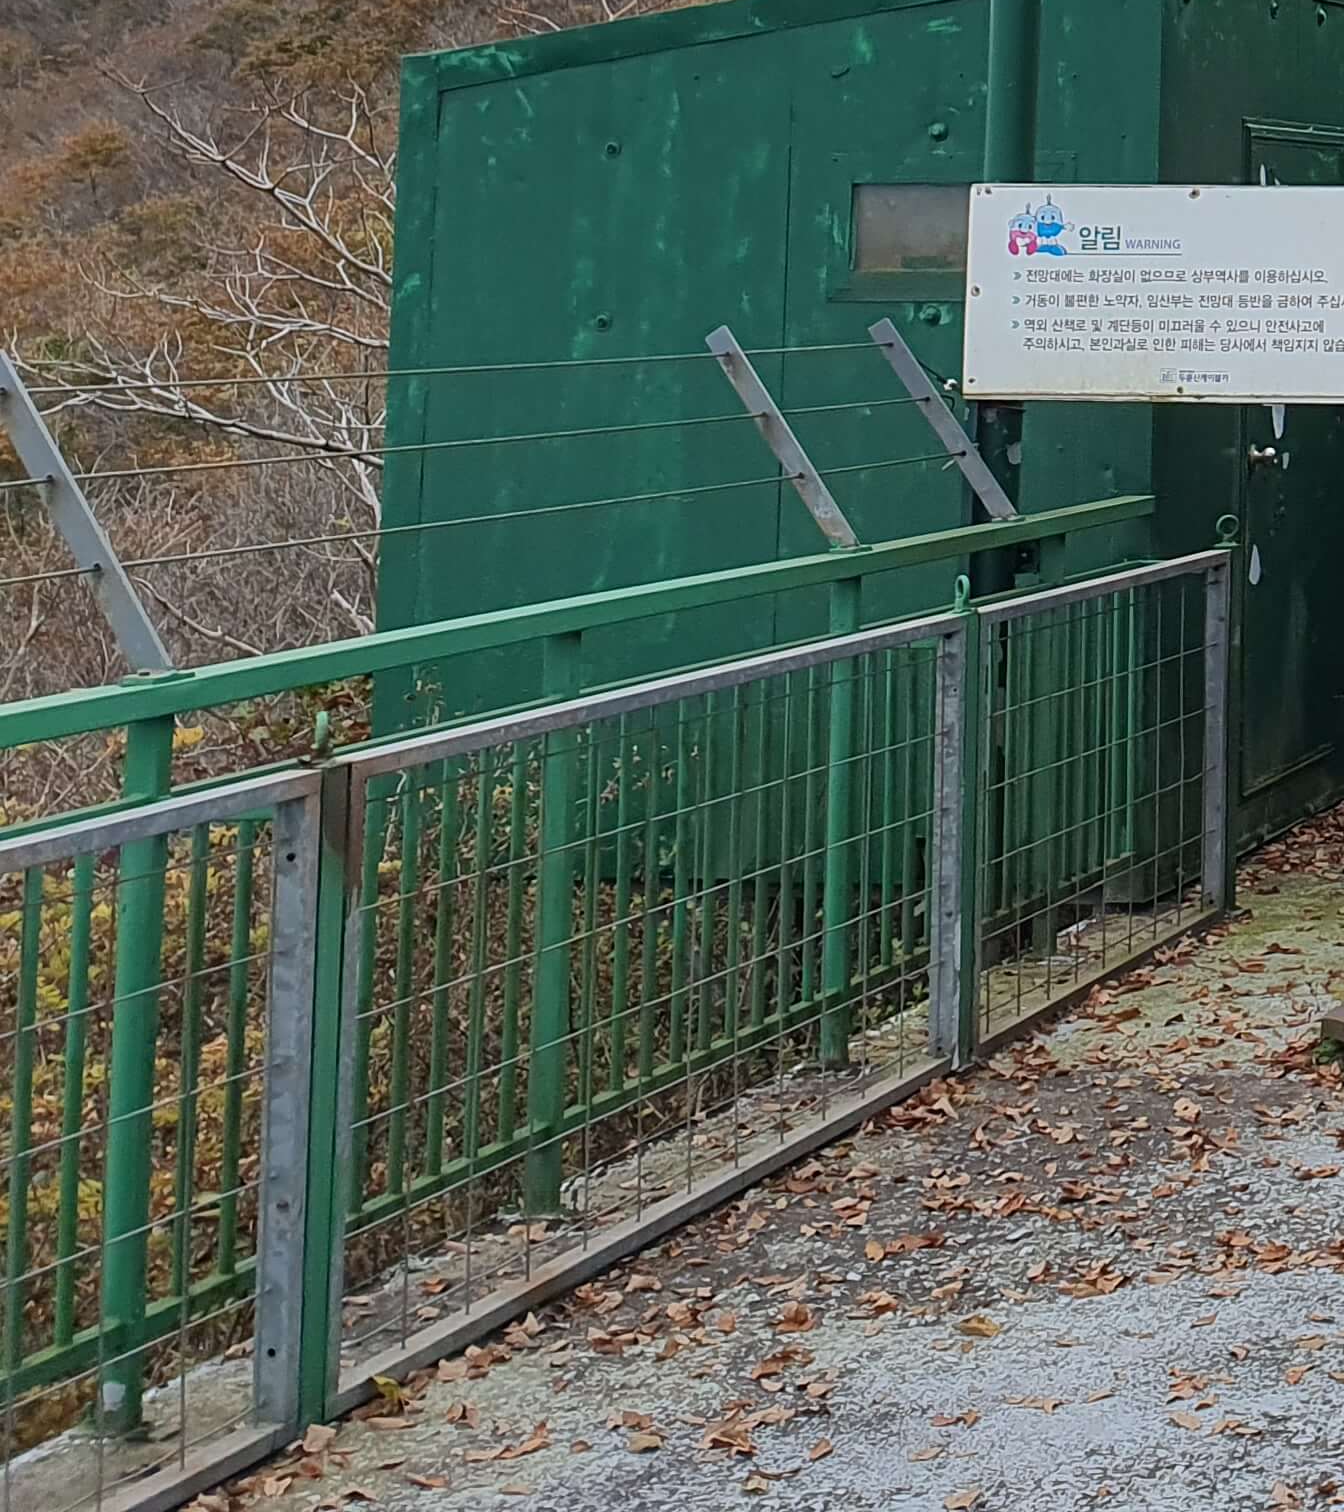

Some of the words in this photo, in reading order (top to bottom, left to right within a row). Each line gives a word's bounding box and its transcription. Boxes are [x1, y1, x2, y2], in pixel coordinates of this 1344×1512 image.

[1079, 225, 1121, 251] 알림
[1125, 239, 1181, 250] WARNING
[1026, 269, 1085, 283] 전망대에는
[1088, 269, 1135, 283] 화장실이
[1140, 269, 1187, 283] 없으므로
[1191, 269, 1249, 284] 상부역사를
[1025, 294, 1060, 308] 거동이
[1064, 294, 1099, 308] 불편한
[1199, 294, 1233, 308] 전망대
[1238, 295, 1272, 308] 등반을
[1276, 295, 1313, 308] 금하여
[1052, 319, 1086, 332] 산책로
[1091, 319, 1103, 332] 및
[1107, 319, 1154, 333] 계단등이
[1209, 319, 1222, 333] 수
[1226, 319, 1261, 333] 있으니
[1265, 319, 1325, 334] 안전사고에
[1089, 338, 1148, 352] 본인과실로
[1153, 338, 1176, 351] 인한
[1180, 338, 1216, 352] 피해는
[1220, 338, 1266, 352] 당사에서
[1271, 339, 1318, 352] 책임지지
